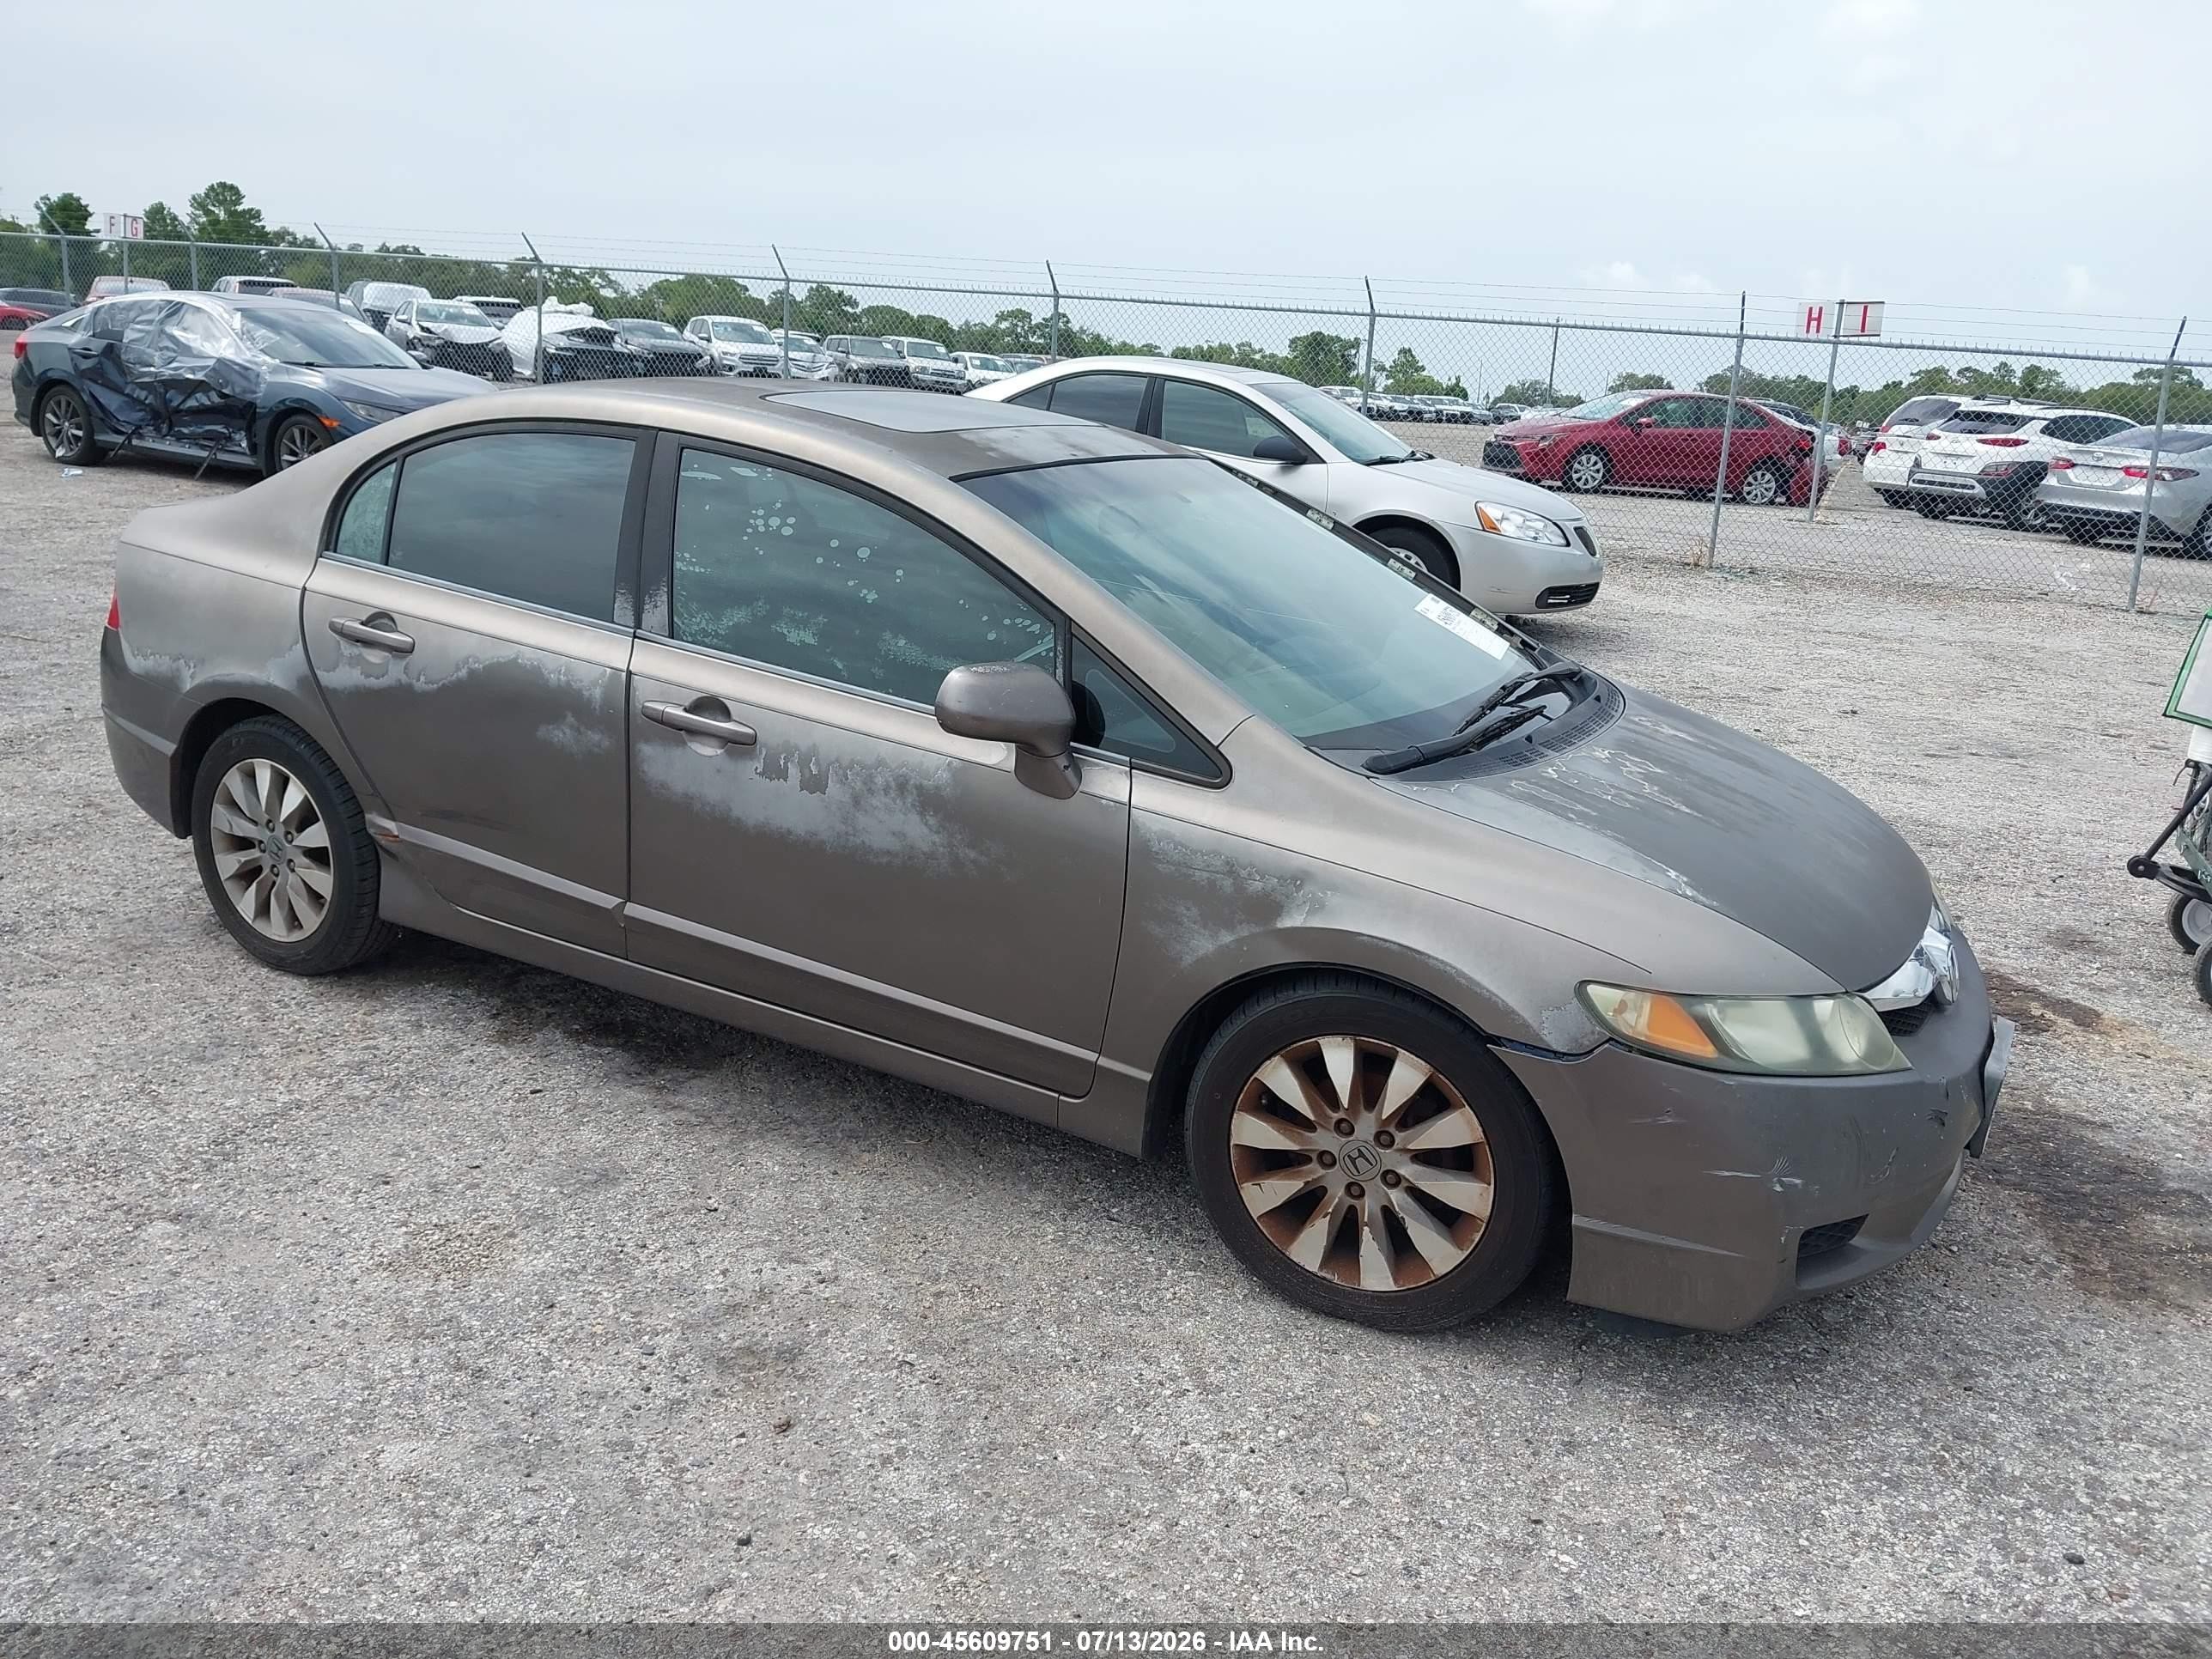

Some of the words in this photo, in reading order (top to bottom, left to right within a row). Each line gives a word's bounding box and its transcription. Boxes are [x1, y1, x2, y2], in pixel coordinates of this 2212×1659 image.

[109, 216, 116, 234] F
[131, 218, 138, 238] G
[1805, 306, 1823, 334] H
[1860, 305, 1869, 333] I
